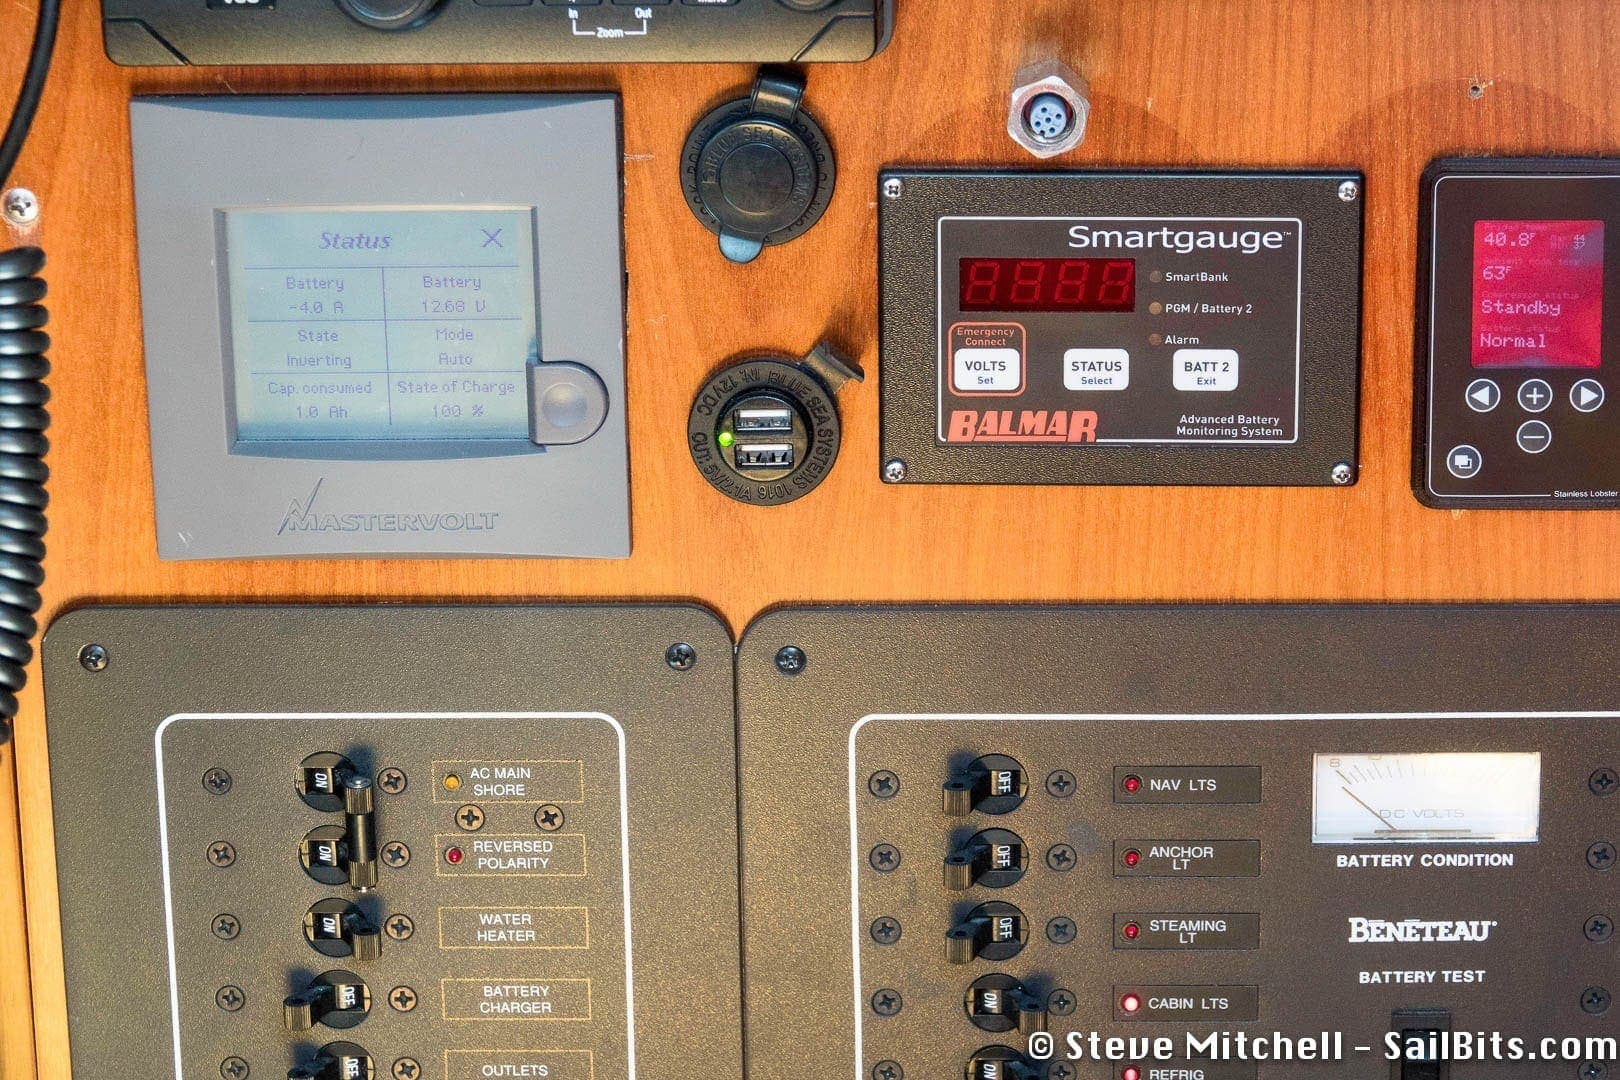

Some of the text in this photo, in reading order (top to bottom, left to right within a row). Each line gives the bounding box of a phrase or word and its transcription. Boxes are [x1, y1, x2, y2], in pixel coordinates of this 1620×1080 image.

[568, 8, 579, 19] In
[635, 8, 652, 19] Out
[596, 27, 624, 39] Zoom
[319, 232, 393, 251] Status
[1573, 241, 1586, 249] 37
[423, 275, 482, 291] Battery
[1165, 272, 1229, 283] SmartBank
[286, 276, 345, 293] Battery
[288, 302, 344, 314] -4.0 A
[476, 301, 487, 313] V
[1165, 304, 1191, 313] PGM
[1201, 303, 1243, 316] Battery
[1245, 304, 1253, 313] 2
[1481, 299, 1561, 317] Standby
[297, 329, 339, 342] State
[435, 328, 474, 341] Mode
[957, 327, 1015, 339] Emergency
[965, 337, 1006, 346] Connect
[1165, 335, 1200, 345] Alarm
[1480, 332, 1547, 348] Normal
[286, 354, 352, 369] Inverting
[438, 353, 473, 366] Auto
[964, 360, 1006, 372] VOLTS
[1071, 360, 1122, 372] STATUS
[1184, 361, 1230, 373] BATT 2
[977, 376, 994, 385] Set
[1081, 376, 1113, 386] Select
[1196, 376, 1217, 386] Exit
[267, 381, 372, 398] Cap. consumed
[397, 380, 515, 397] State of Charge
[296, 405, 348, 418] 1.0 Ah
[432, 405, 484, 418] 100 %
[1180, 413, 1280, 426] Advanced Battery
[946, 410, 1099, 443] BALMAR
[1176, 425, 1283, 439] Monitoring System
[757, 370, 834, 500] BLUE SEA SYSTEMS 1016
[1554, 490, 1618, 498] Stainless Lobster
[470, 767, 531, 779] AC MAIN
[314, 772, 328, 789] ON
[998, 771, 1012, 793] OFF
[1150, 779, 1217, 791] NAV LTS
[473, 784, 525, 796] SHORE
[1380, 809, 1465, 818] DC VOLTS
[473, 841, 553, 852] REVERSED
[1149, 846, 1214, 858] ANCHOR
[318, 845, 332, 862] ON
[997, 845, 1010, 867] OFF
[478, 857, 549, 870] POLARITY
[1173, 859, 1190, 870] LT
[1336, 853, 1514, 867] BATTERY CONDITION
[322, 916, 336, 934] ON
[479, 914, 532, 925] WATER
[999, 917, 1012, 939] OFF
[1149, 920, 1227, 932] STEAMING
[477, 930, 536, 942] HEATER
[1179, 932, 1198, 944] LT
[1359, 970, 1486, 983] BATTERY TEST
[342, 986, 356, 1007] OFF
[483, 985, 550, 998] BATTERY
[984, 992, 998, 1009] ON
[1148, 998, 1229, 1010] CABIN LTS
[480, 1002, 552, 1014] CHARGER
[345, 1058, 359, 1079] OFF
[482, 1065, 549, 1077] OUTLETS
[984, 1063, 997, 1080] ON
[1150, 1069, 1204, 1080] REFRIG
